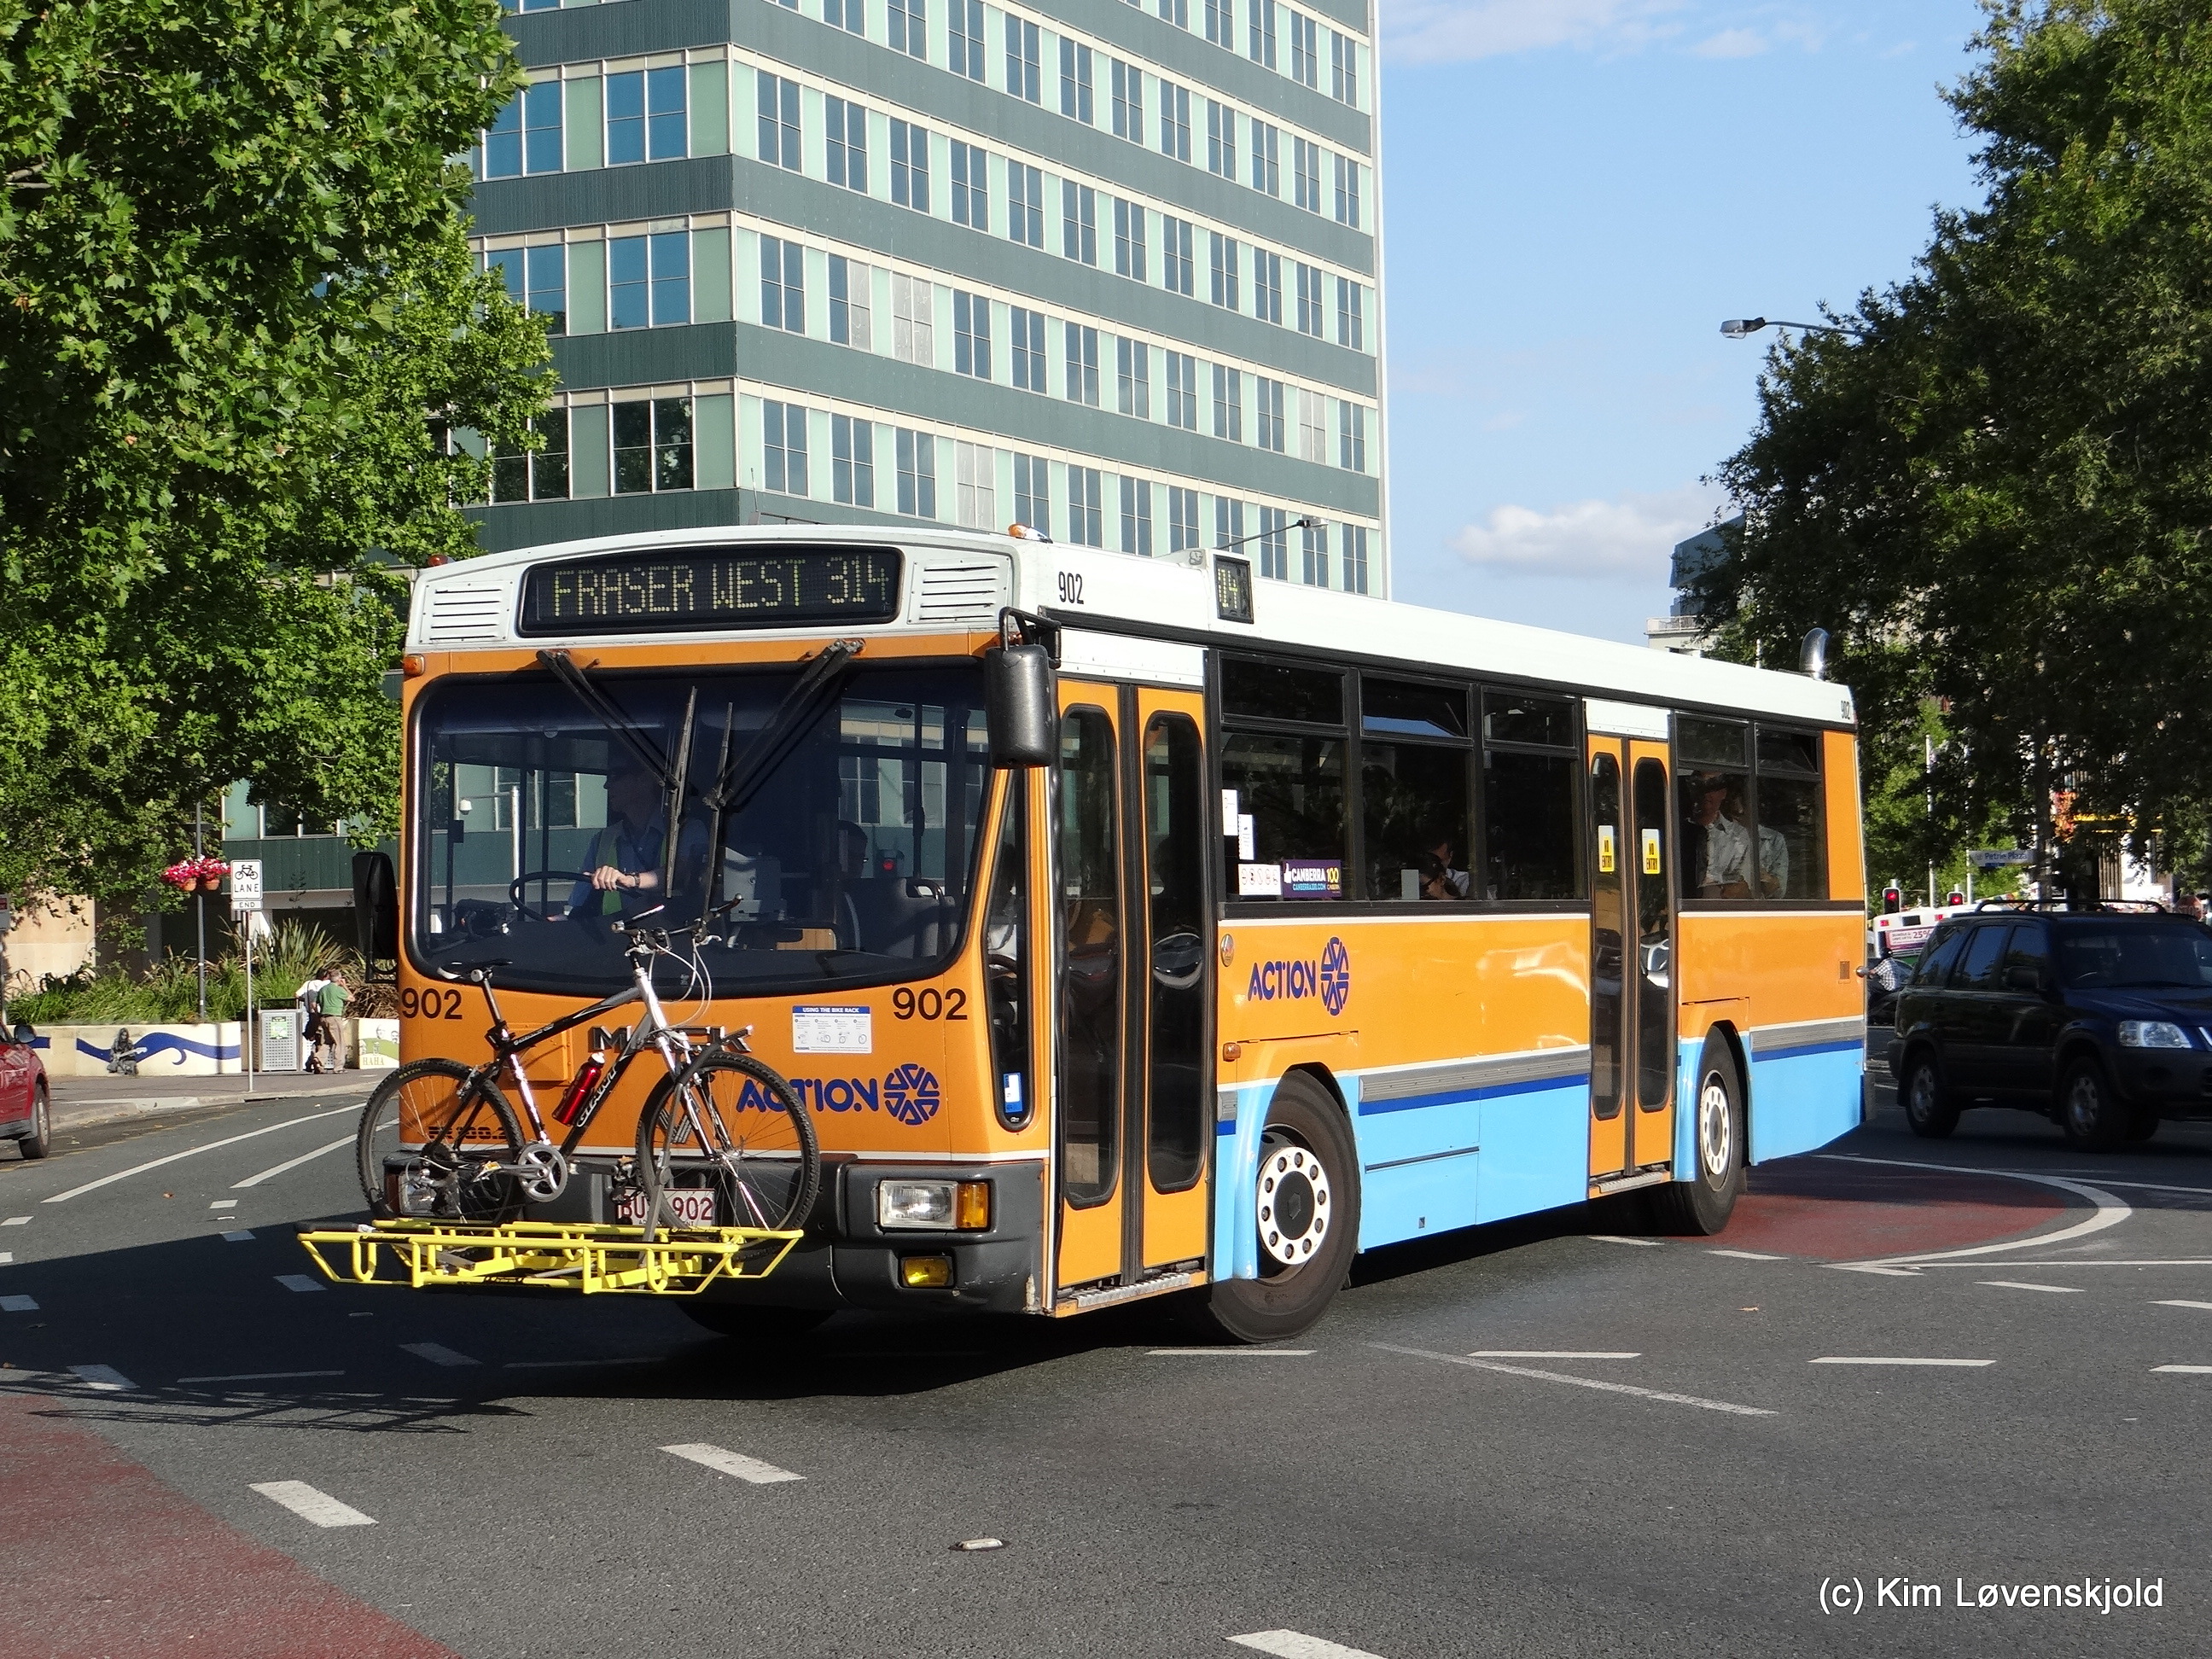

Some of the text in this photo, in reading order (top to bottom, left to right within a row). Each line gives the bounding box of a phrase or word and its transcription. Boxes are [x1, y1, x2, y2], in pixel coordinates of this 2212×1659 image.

[554, 555, 889, 616] FRASER WEST 314
[1058, 571, 1085, 605] 902
[1840, 700, 1850, 719] 902
[1602, 855, 1612, 868] ENTRY
[1646, 858, 1658, 870] ENTRY
[2007, 852, 2028, 860] Plaza
[1291, 867, 1339, 883] CANBERRA 100
[234, 883, 259, 893] LANE
[1247, 959, 1316, 1002] ACTION
[400, 987, 463, 1020] 902
[892, 987, 969, 1021] 902
[363, 1057, 385, 1066] HAHA
[736, 1077, 880, 1113] ACTION
[672, 1196, 714, 1221] 902
